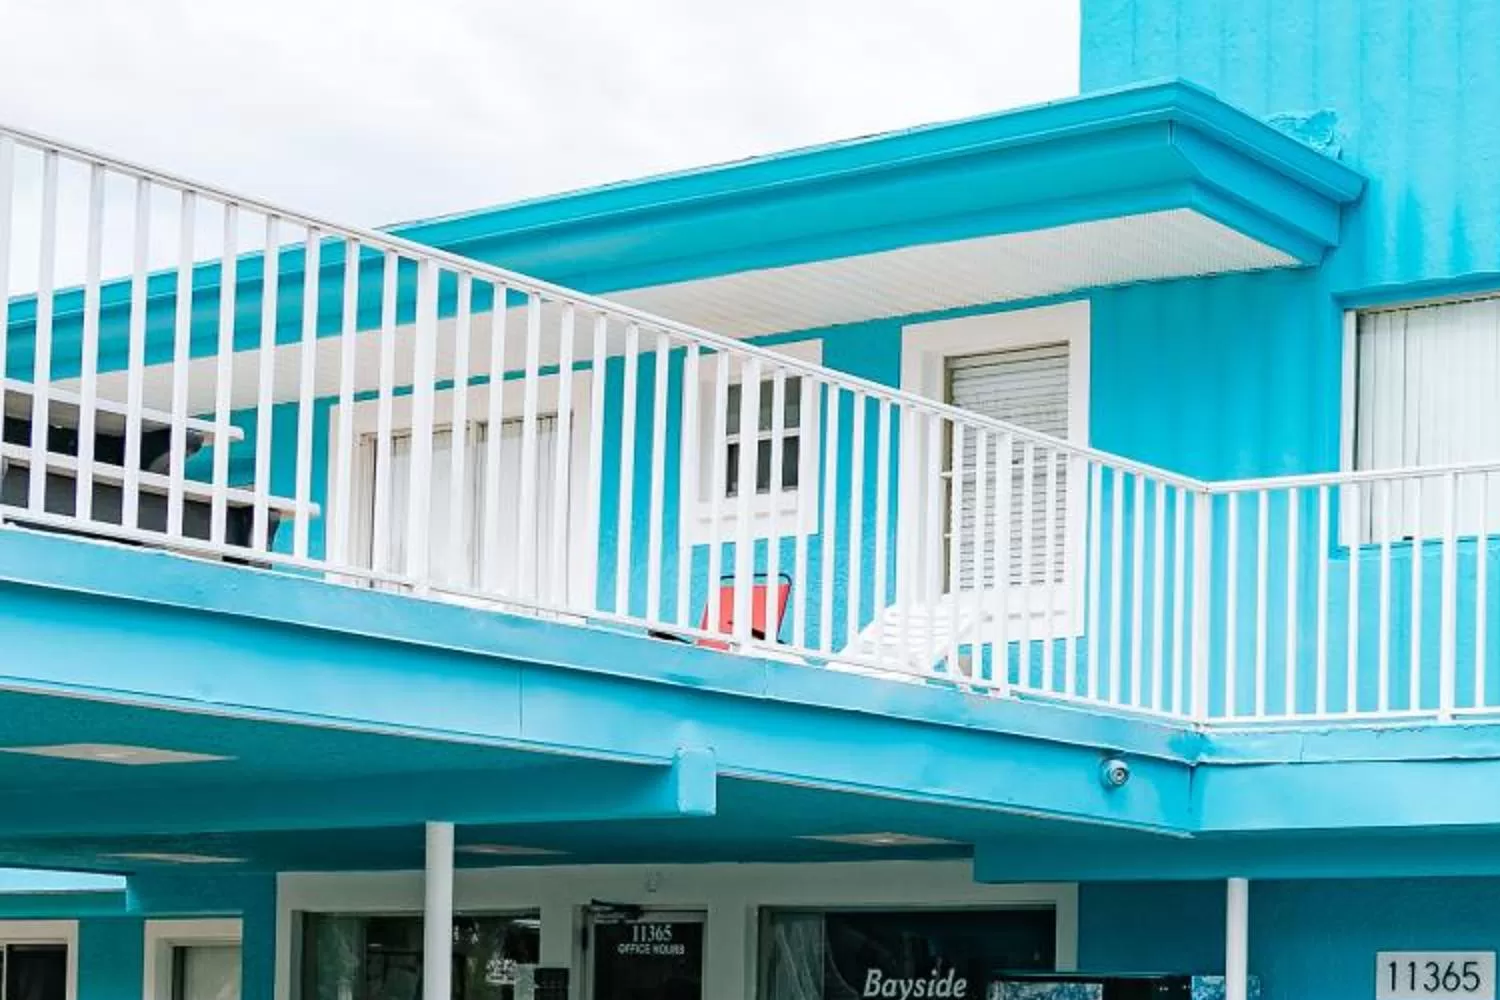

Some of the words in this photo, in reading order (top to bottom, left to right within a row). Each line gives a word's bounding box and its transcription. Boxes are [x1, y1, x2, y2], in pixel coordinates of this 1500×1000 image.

[632, 924, 673, 942] 11365
[617, 943, 651, 955] OFFICE
[652, 943, 685, 955] HOURS
[1389, 961, 1481, 992] 11365
